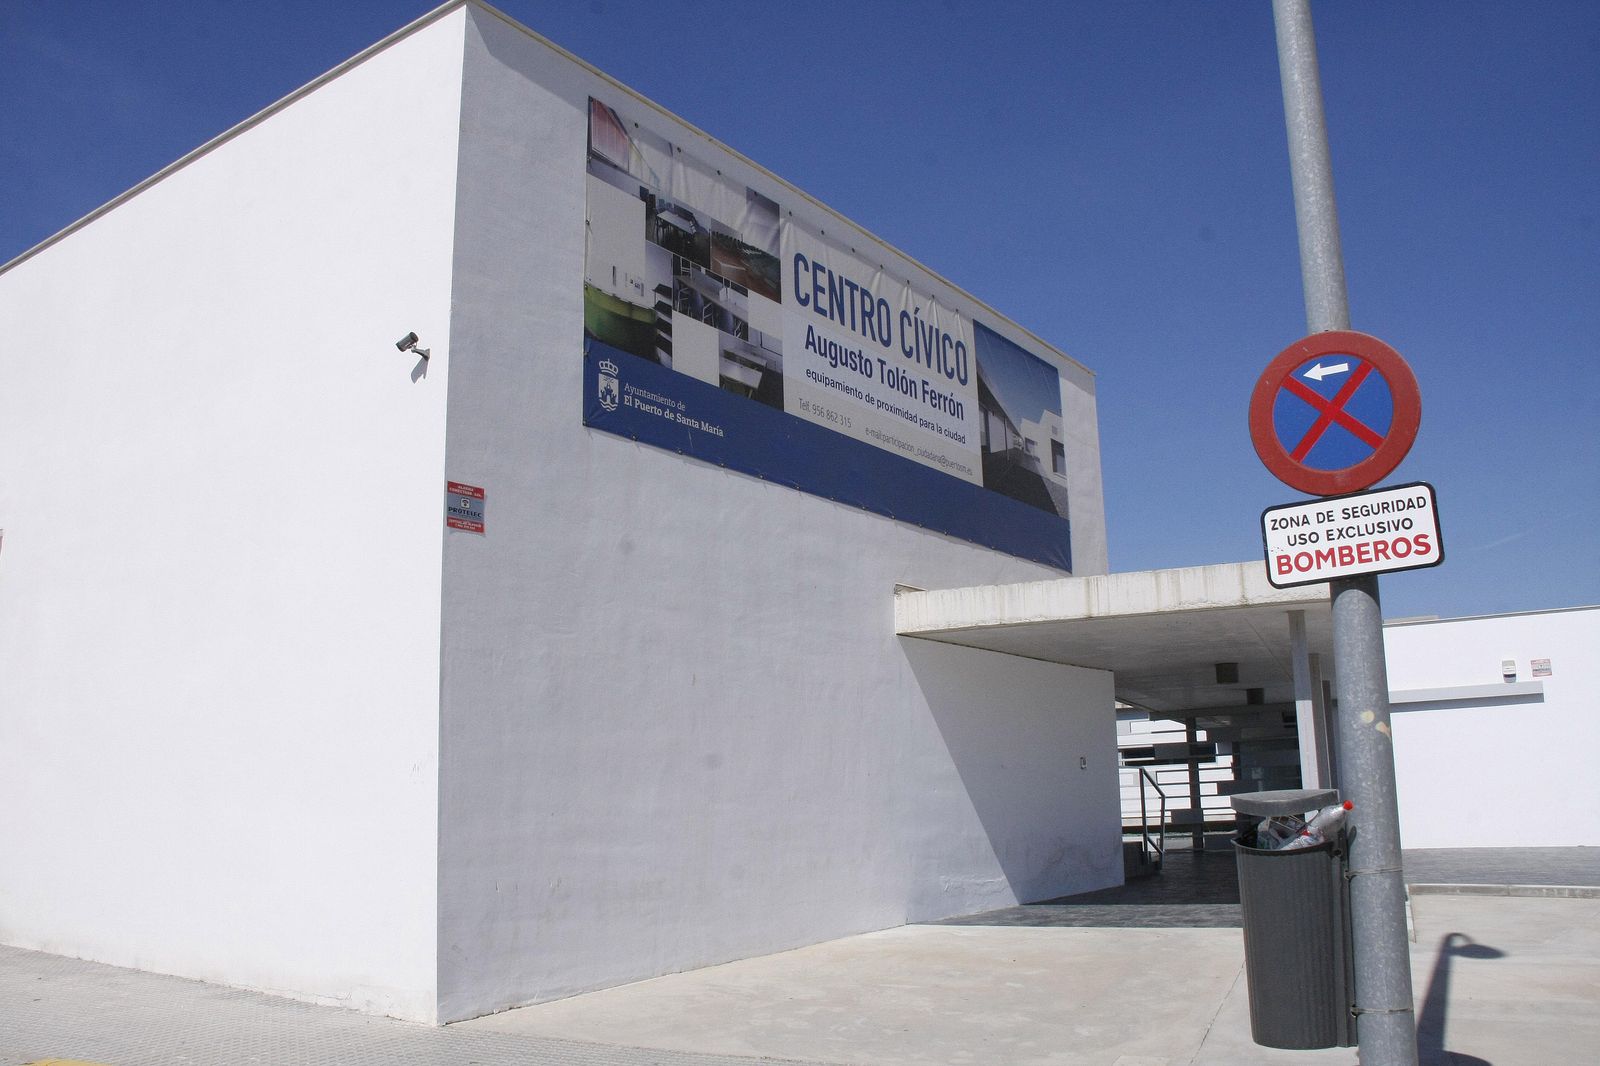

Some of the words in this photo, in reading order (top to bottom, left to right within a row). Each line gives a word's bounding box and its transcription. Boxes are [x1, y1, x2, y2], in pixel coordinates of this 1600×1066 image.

[794, 253, 892, 348] CENTRO
[900, 307, 968, 386] CÍVICO
[805, 324, 873, 378] Augusto
[877, 358, 918, 399] Tolón
[922, 379, 964, 421] Ferrón
[624, 383, 676, 408] Ayuntamiento
[675, 401, 686, 411] de
[624, 395, 633, 407] El
[634, 400, 663, 417] Puerto
[664, 409, 675, 421] de
[676, 413, 700, 429] Santa
[701, 421, 724, 437] María
[806, 369, 863, 400] equipamiento
[865, 393, 875, 405] de
[876, 399, 918, 423] proximidad
[919, 418, 935, 431] para
[936, 423, 943, 434] la
[944, 428, 966, 444] ciudad
[812, 404, 825, 418] 956
[839, 415, 852, 428] 315
[1270, 514, 1311, 531] ZONA
[1316, 510, 1335, 524] DE
[1341, 496, 1427, 520] SEGURIDAD
[1287, 531, 1320, 547] USO
[1326, 517, 1414, 541] EXCLUSIVO
[1276, 533, 1432, 576] BOMBEROS
